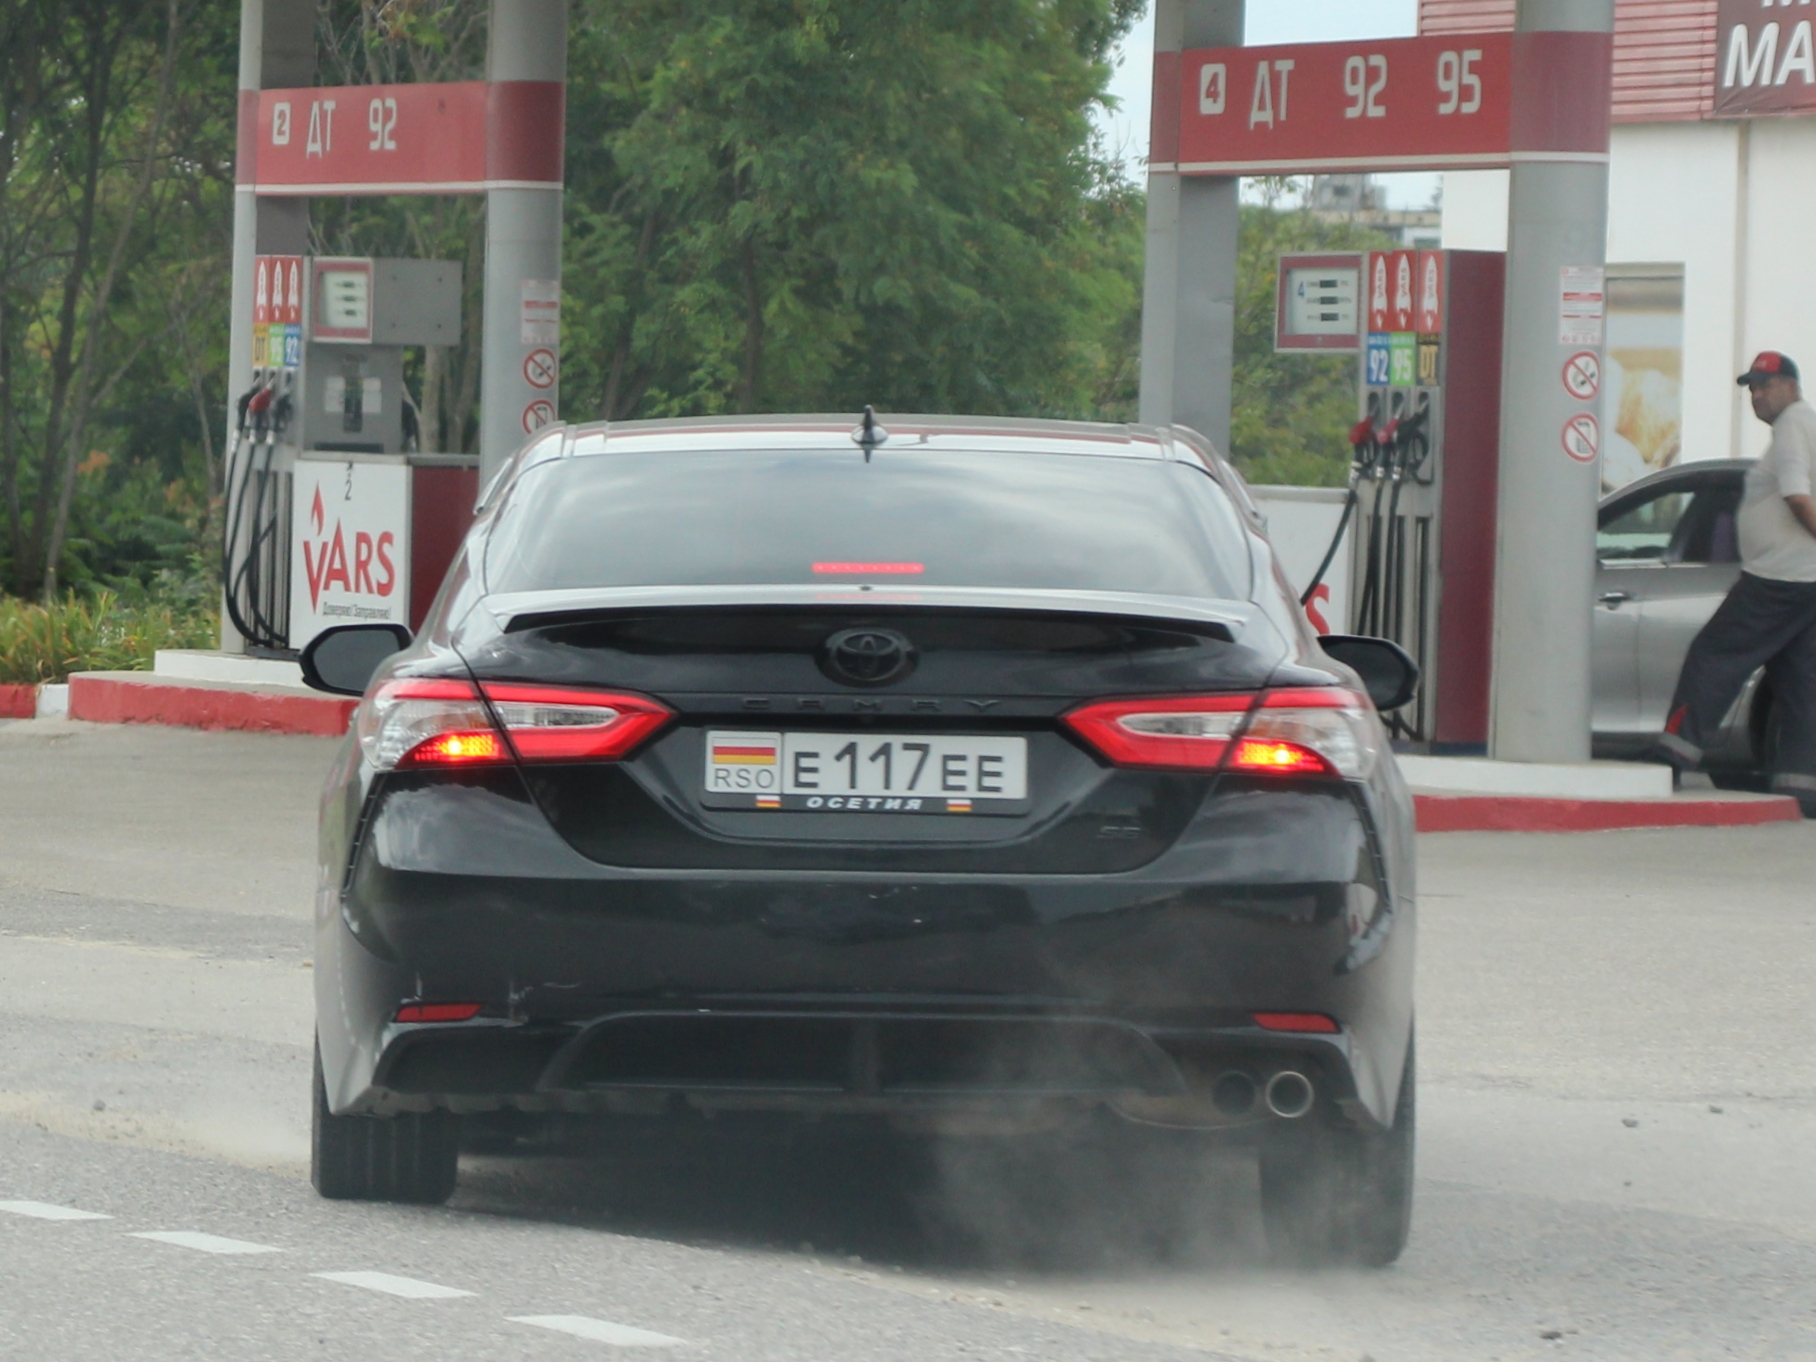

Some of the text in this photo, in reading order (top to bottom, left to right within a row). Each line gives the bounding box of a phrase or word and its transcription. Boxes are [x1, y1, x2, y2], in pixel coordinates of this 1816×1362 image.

[1205, 49, 1483, 131] 4 ДТ 92 95
[276, 109, 287, 137] 2
[369, 98, 397, 150] 92
[1370, 349, 1389, 382] 92
[1393, 349, 1412, 381] 95
[303, 517, 395, 615] VARS
[714, 768, 775, 789] RSO
[806, 796, 924, 811] ОСЕТИЯ
